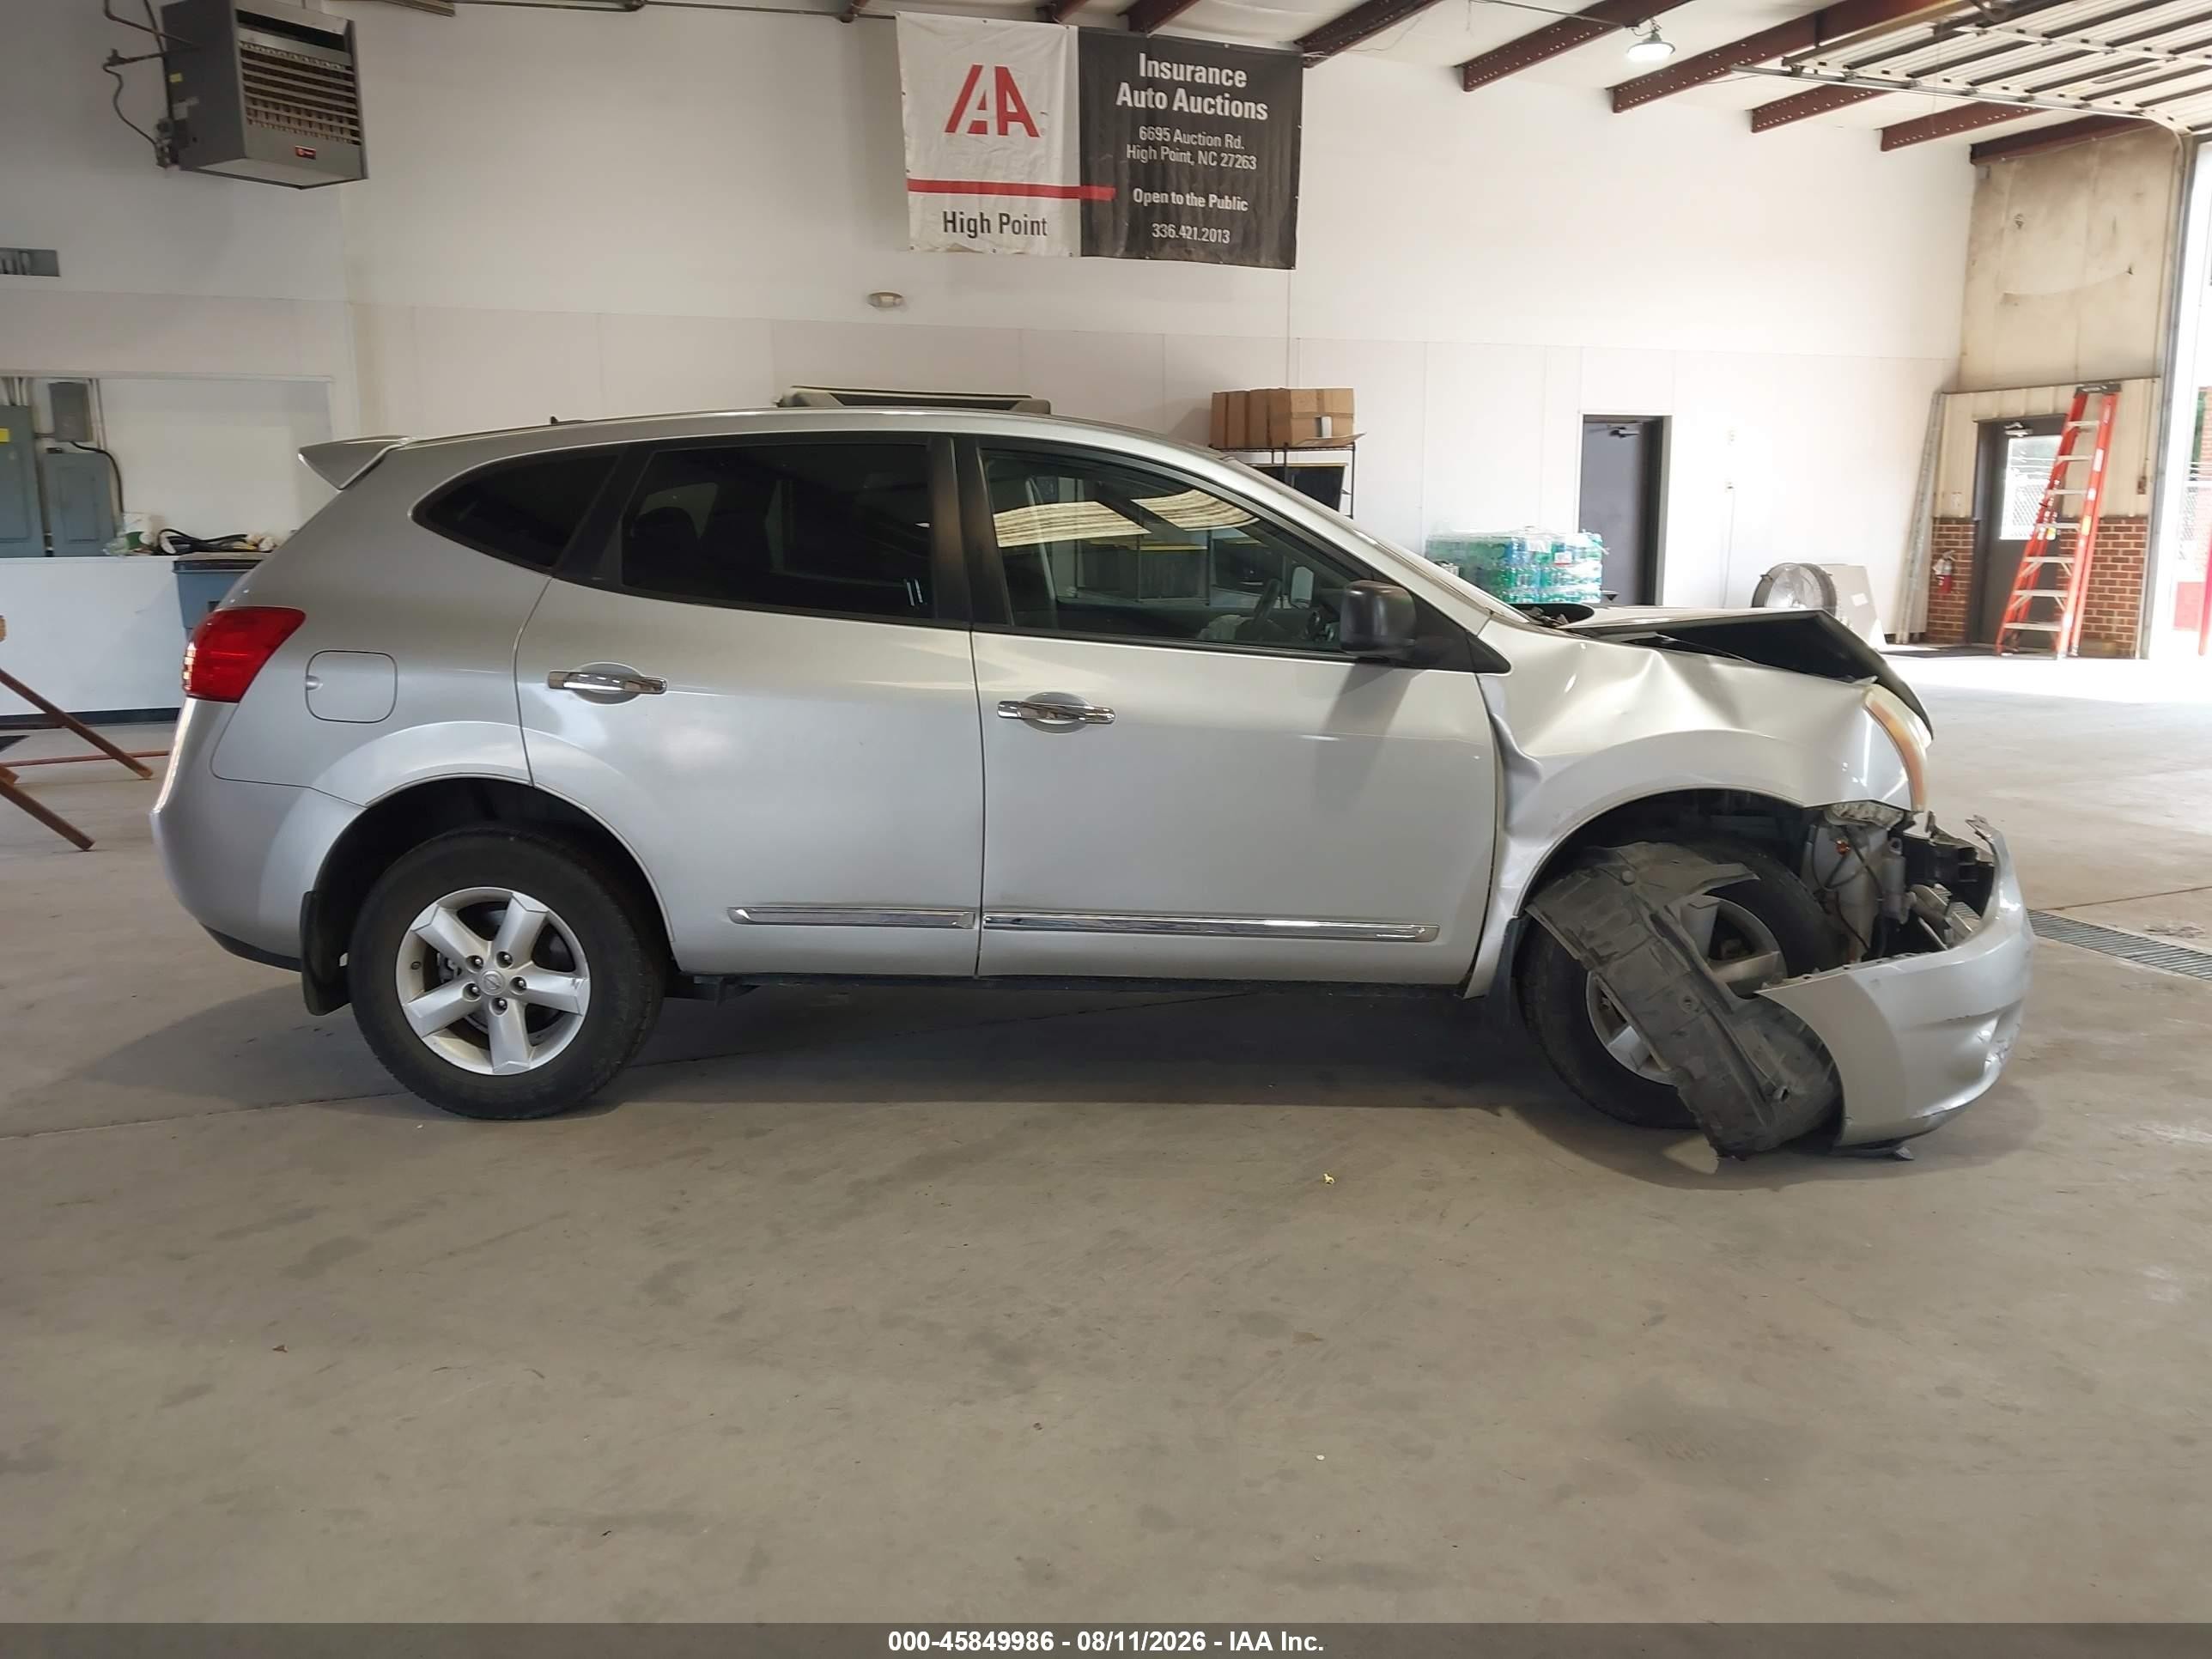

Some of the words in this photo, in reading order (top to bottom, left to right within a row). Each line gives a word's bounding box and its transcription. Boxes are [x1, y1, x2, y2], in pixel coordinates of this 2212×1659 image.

[1139, 52, 1248, 88] Insurance
[1116, 82, 1169, 110] Auto
[1172, 88, 1269, 121] Auctions
[1139, 125, 1171, 142] 6695
[1173, 129, 1222, 147] Auction
[1224, 133, 1245, 150] Rd.
[1126, 143, 1158, 163] High
[1160, 145, 1195, 166] Point,
[1198, 150, 1218, 167] NC
[1220, 153, 1257, 170] 27263
[1133, 187, 1169, 206] Open
[1170, 191, 1184, 205] to
[1186, 191, 1206, 207] the
[1208, 193, 1249, 211] Public
[942, 210, 992, 240] High
[998, 212, 1048, 237] Point
[1152, 222, 1231, 244] 336.421.2013
